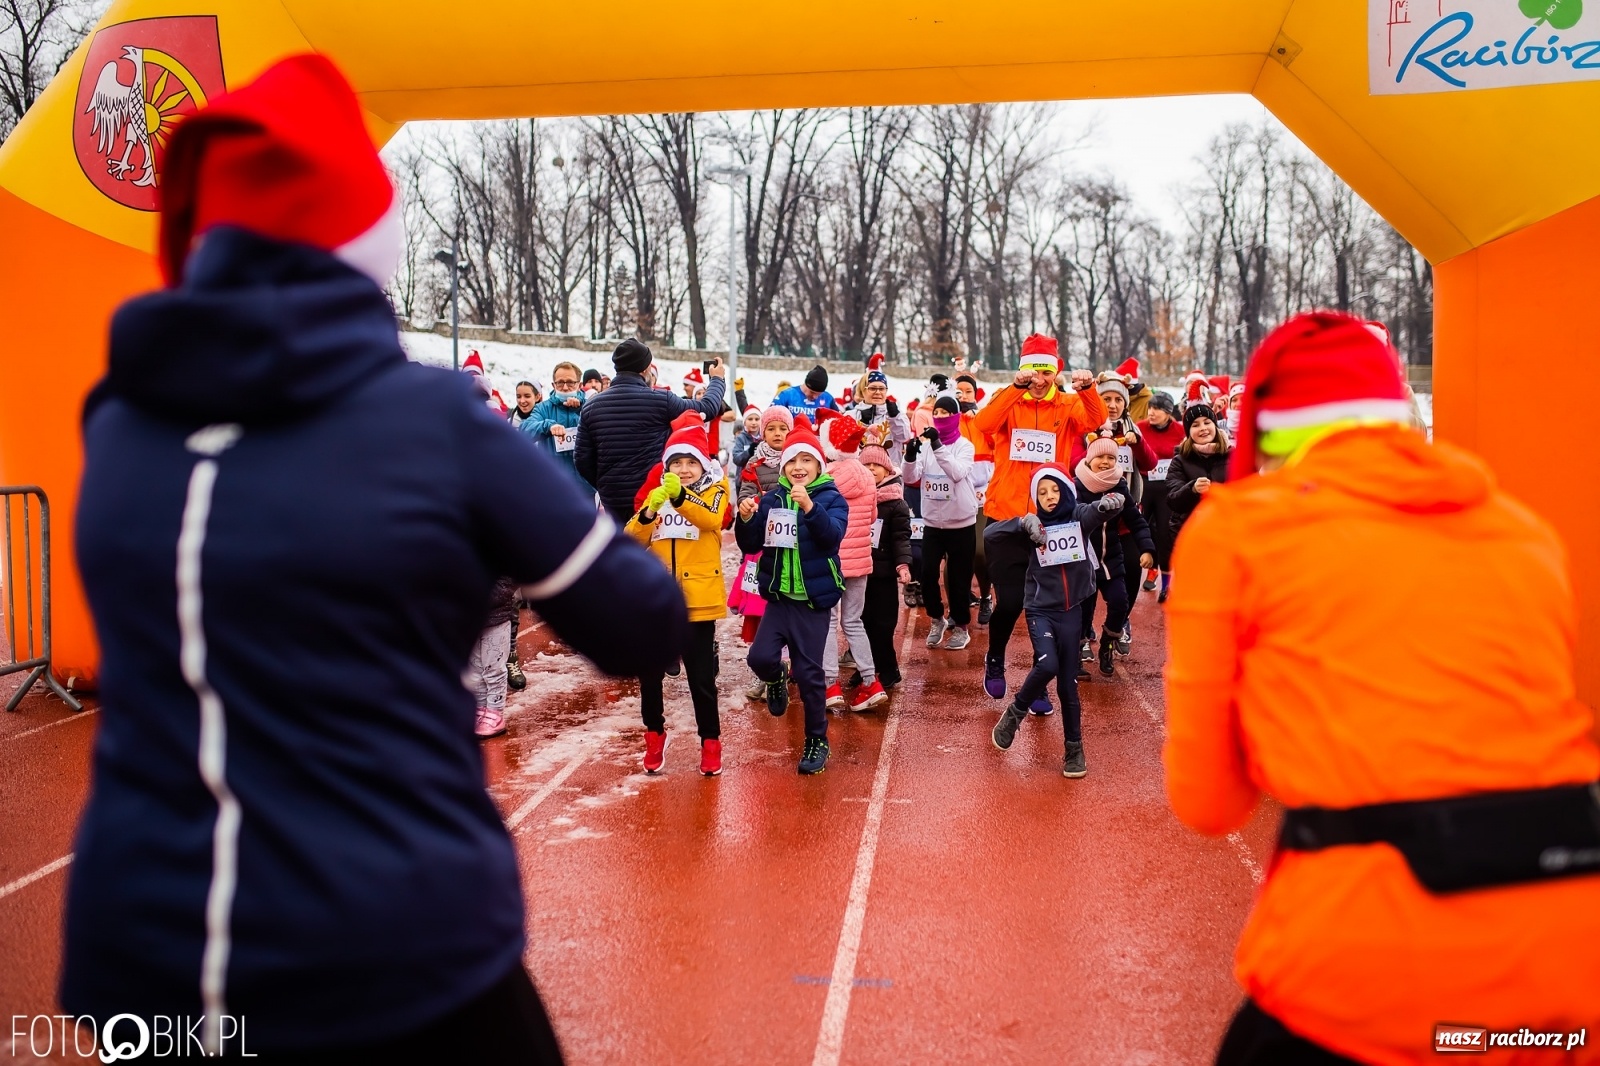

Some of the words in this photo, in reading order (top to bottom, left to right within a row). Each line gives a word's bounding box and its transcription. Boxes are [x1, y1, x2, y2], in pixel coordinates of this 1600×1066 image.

[1545, 4, 1557, 17] ISO
[1395, 11, 1600, 88] Racibórz
[788, 405, 816, 416] RUNN
[1027, 441, 1052, 454] 052
[1118, 454, 1129, 464] 33
[1157, 466, 1168, 474] 05
[932, 483, 950, 492] 018
[774, 522, 797, 537] 016
[1048, 535, 1078, 552] 002
